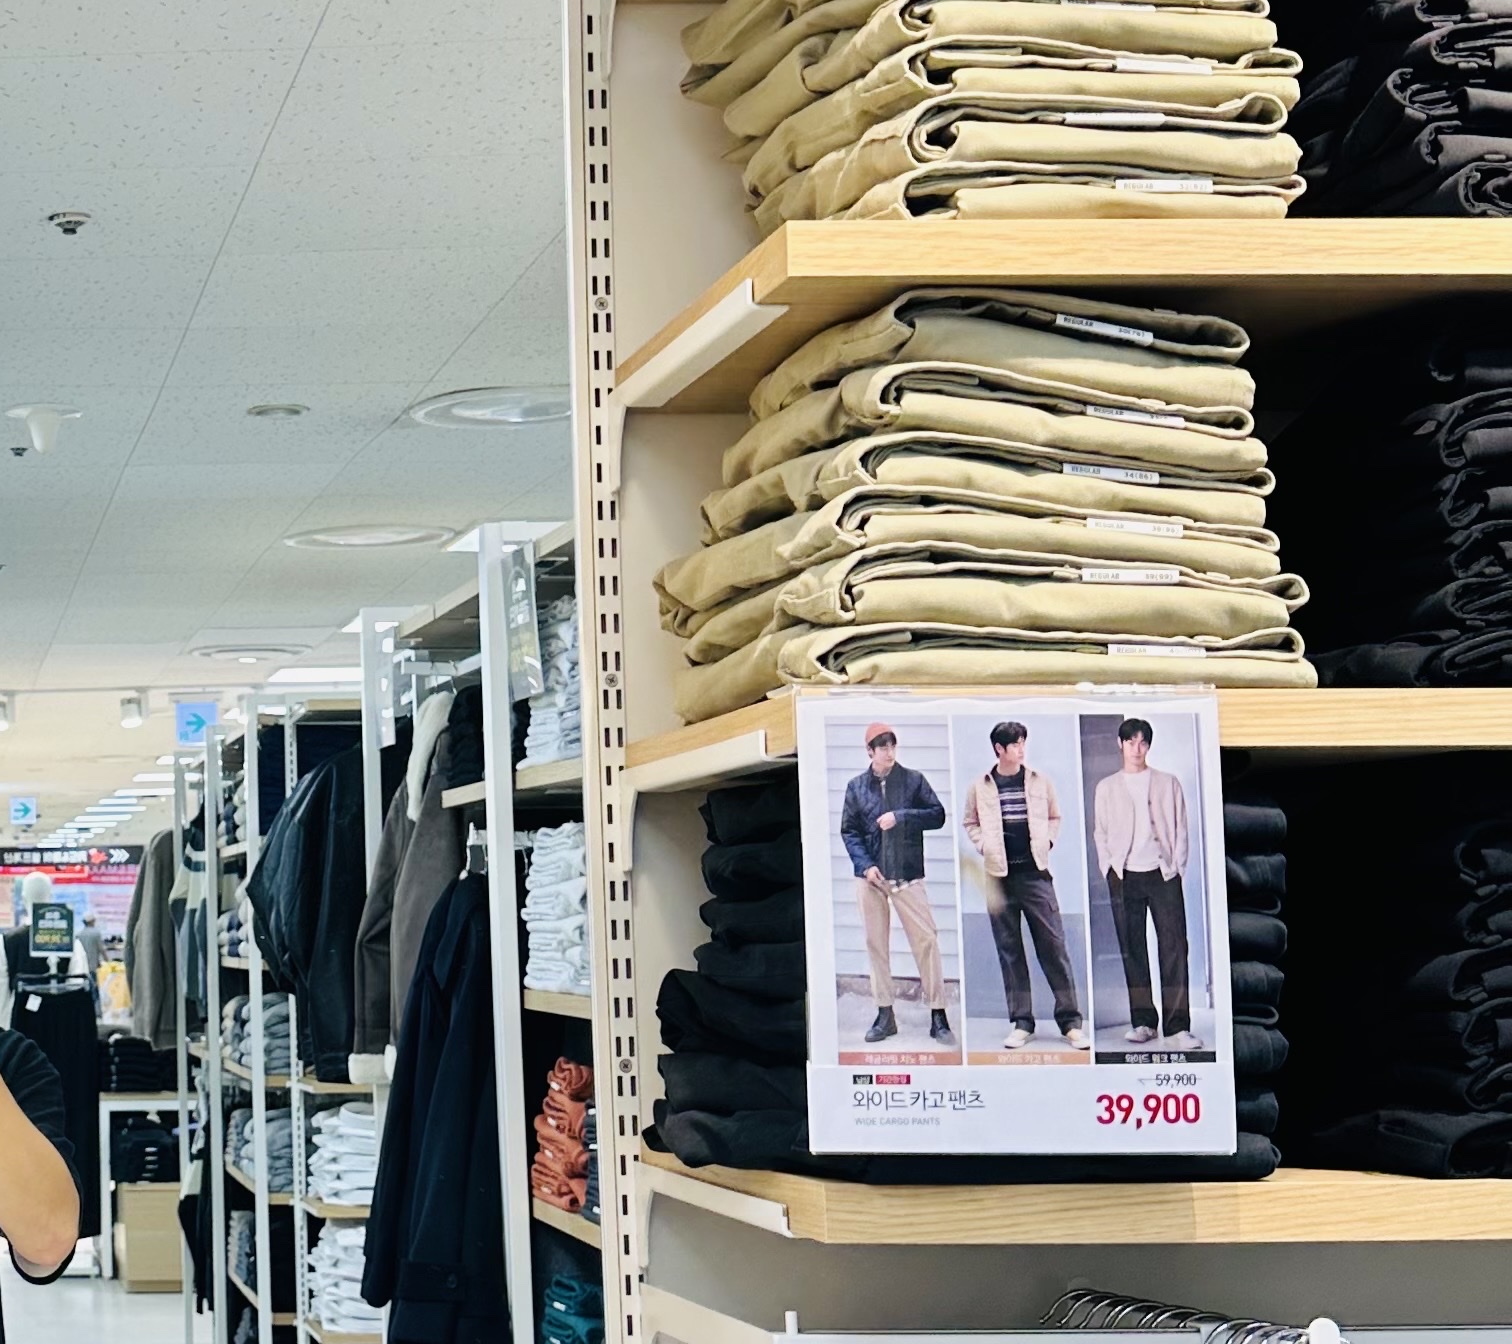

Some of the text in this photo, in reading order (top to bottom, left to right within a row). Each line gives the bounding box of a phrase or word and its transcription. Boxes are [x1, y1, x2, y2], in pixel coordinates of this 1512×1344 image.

[1155, 1073, 1197, 1088] 59,900
[852, 1090, 986, 1111] 와이드 카고 팬츠
[854, 1116, 941, 1126] WIDE CARGO PANTS
[1096, 1093, 1201, 1131] 39,900
